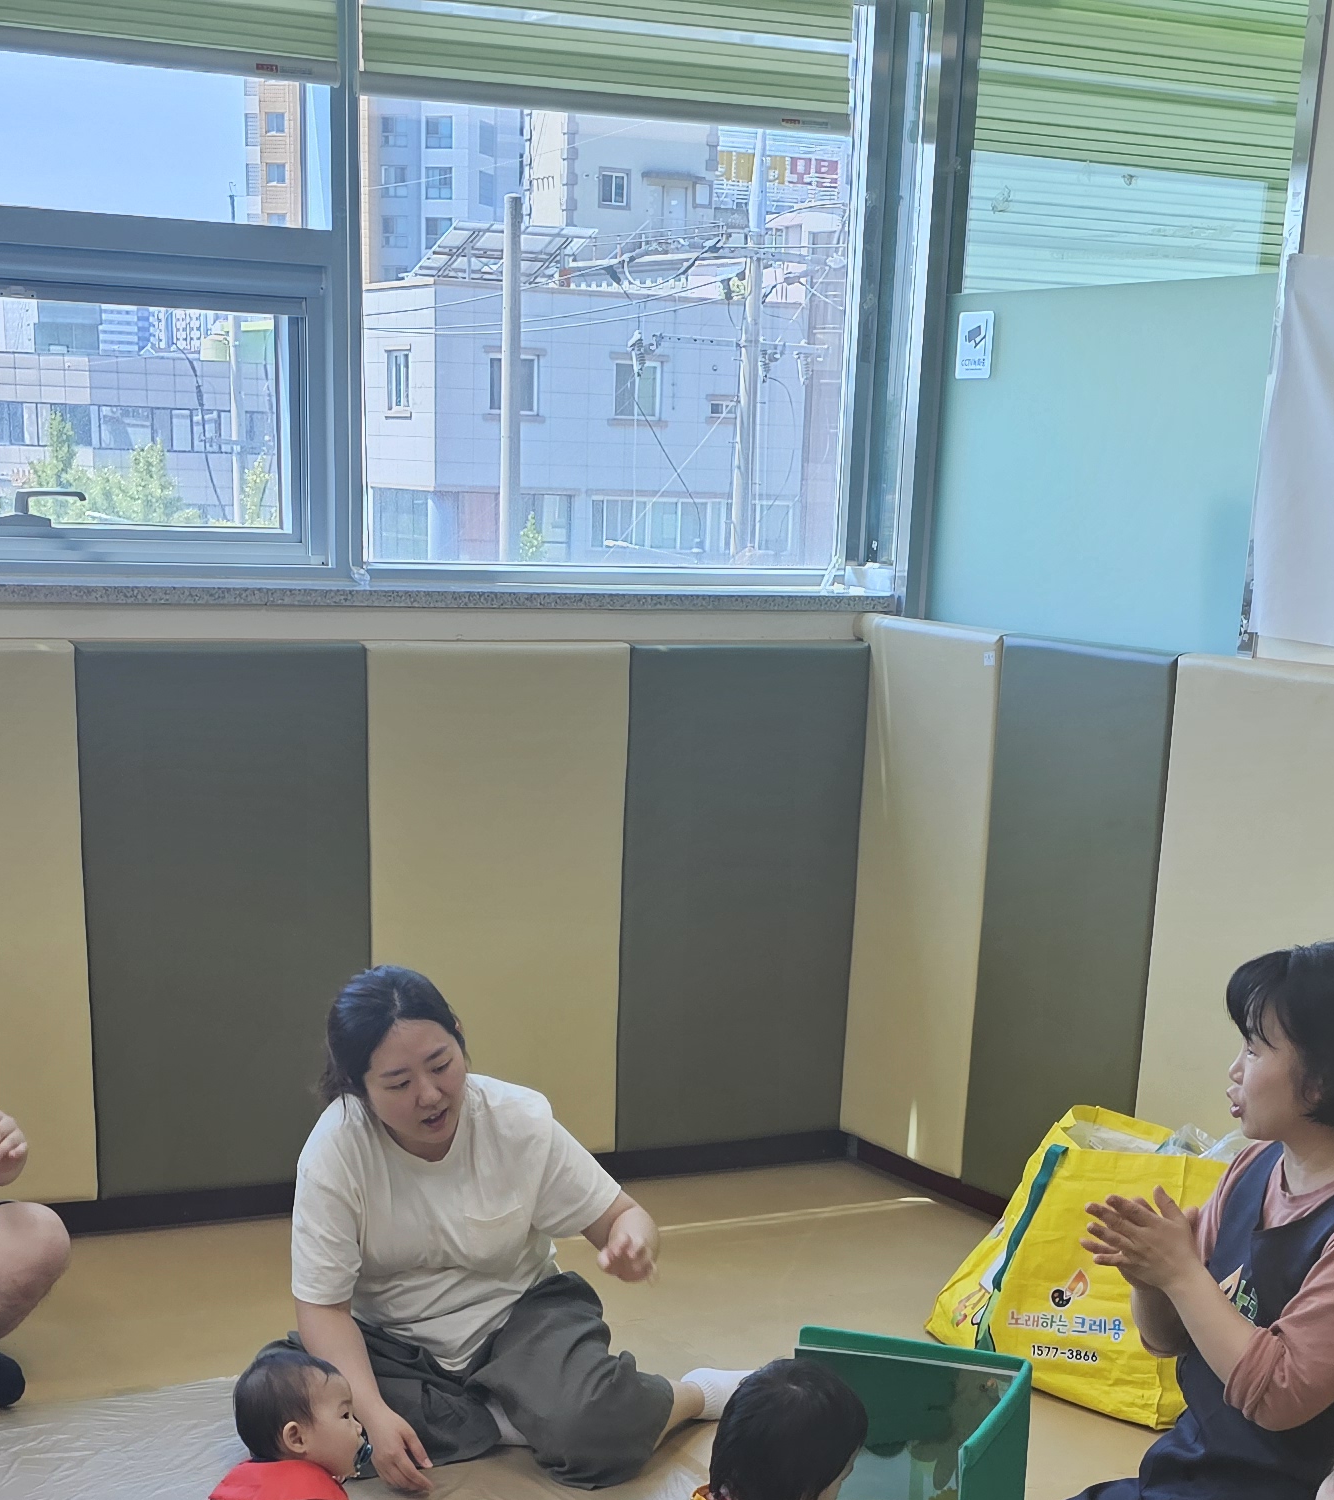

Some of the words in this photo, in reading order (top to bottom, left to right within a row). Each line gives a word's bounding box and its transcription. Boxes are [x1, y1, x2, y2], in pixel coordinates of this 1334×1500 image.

[1007, 1310, 1069, 1335] 노래하는
[1071, 1315, 1126, 1341] 크레용
[1031, 1344, 1099, 1363] 1577-3866
